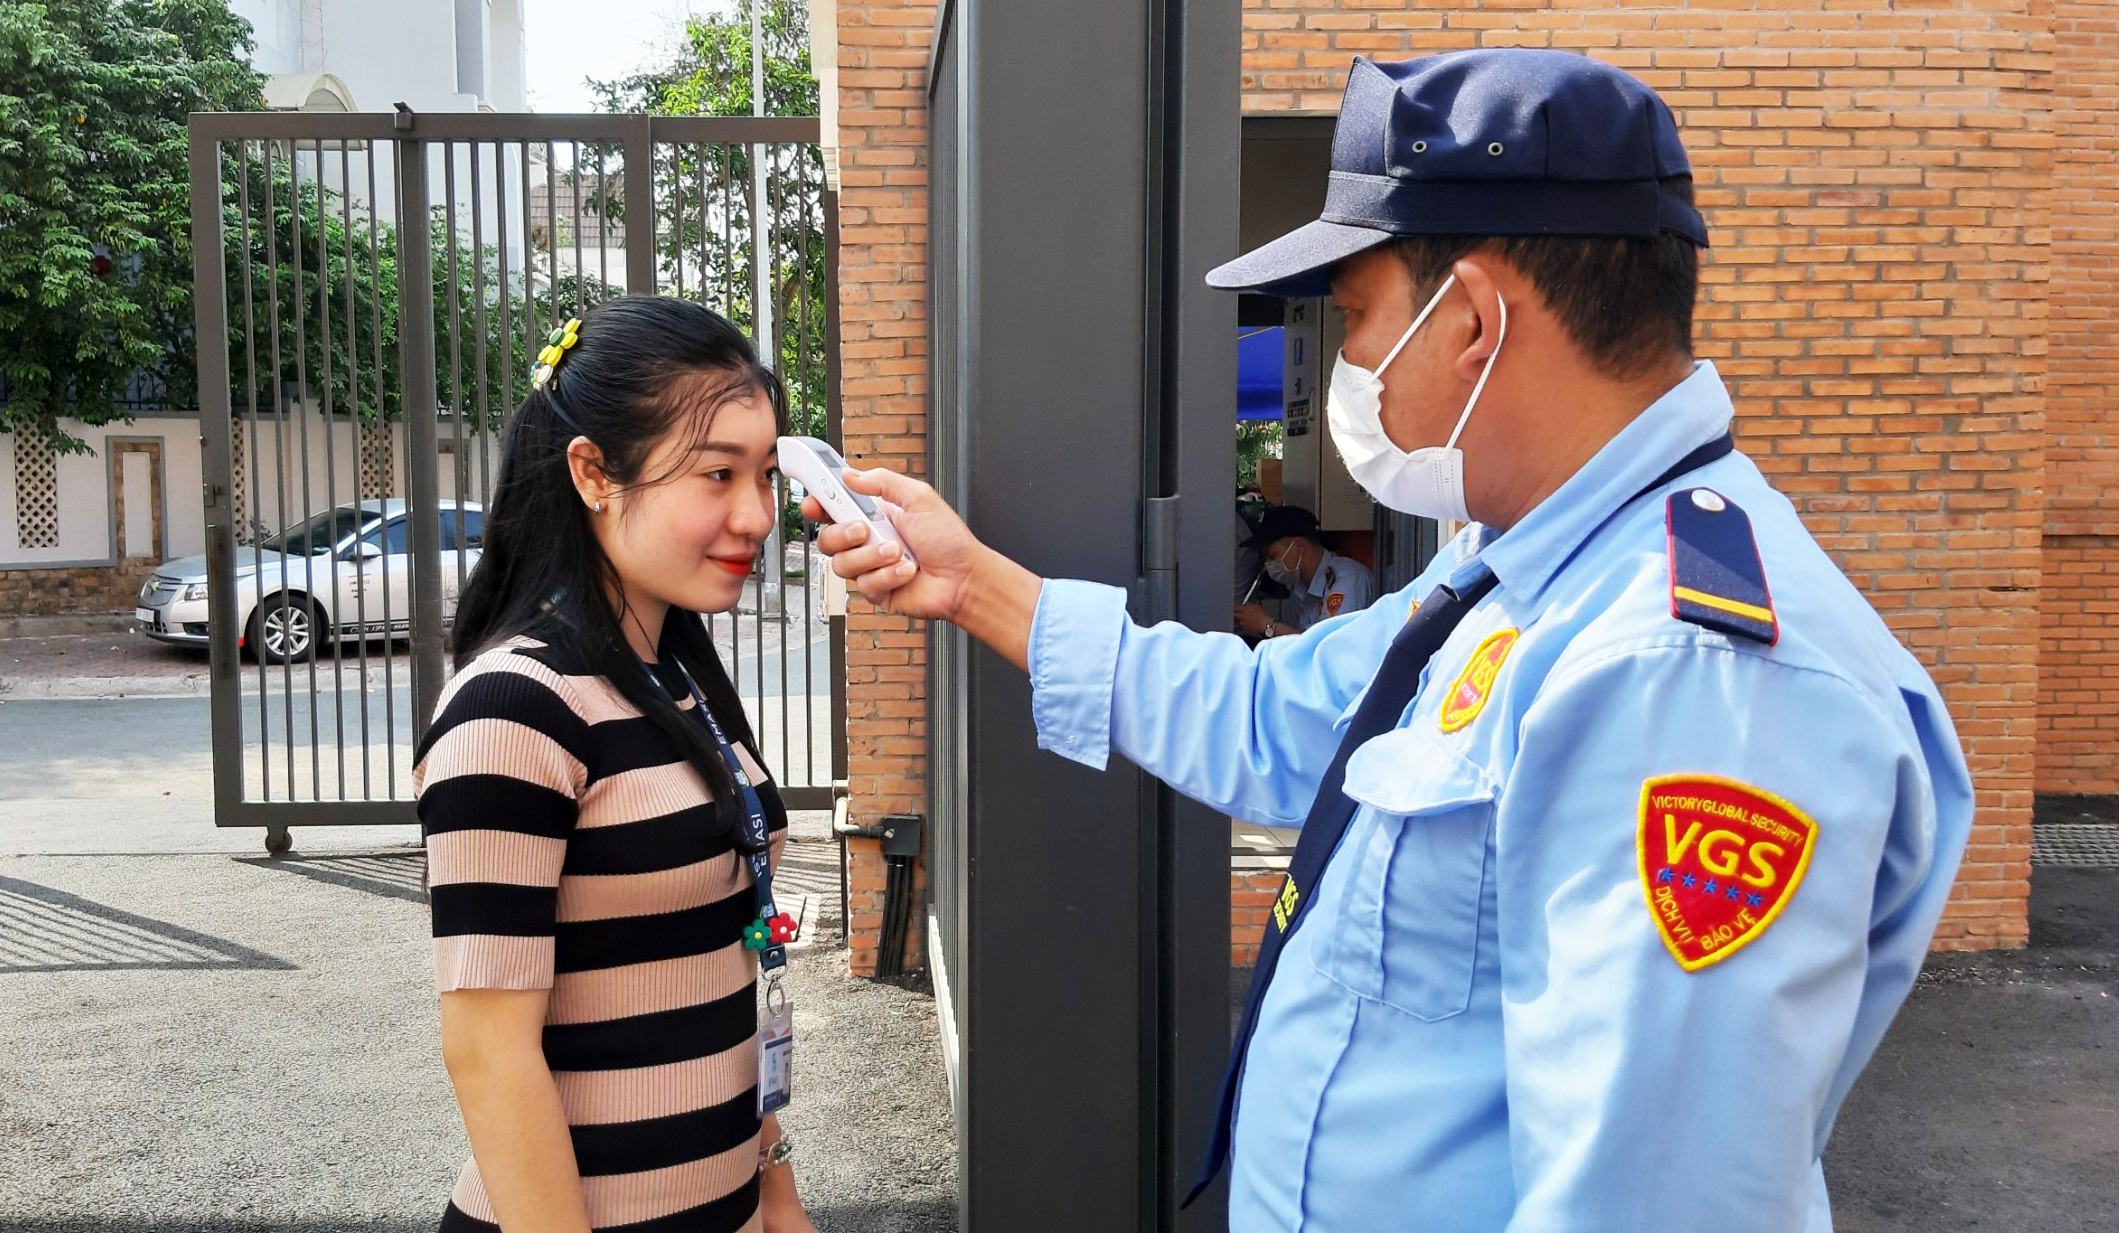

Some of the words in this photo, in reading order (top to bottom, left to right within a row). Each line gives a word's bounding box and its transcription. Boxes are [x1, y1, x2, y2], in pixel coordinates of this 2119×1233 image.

[751, 813, 767, 867] EASI
[1664, 813, 1785, 889] VGS
[1750, 813, 1806, 848] SECURITY
